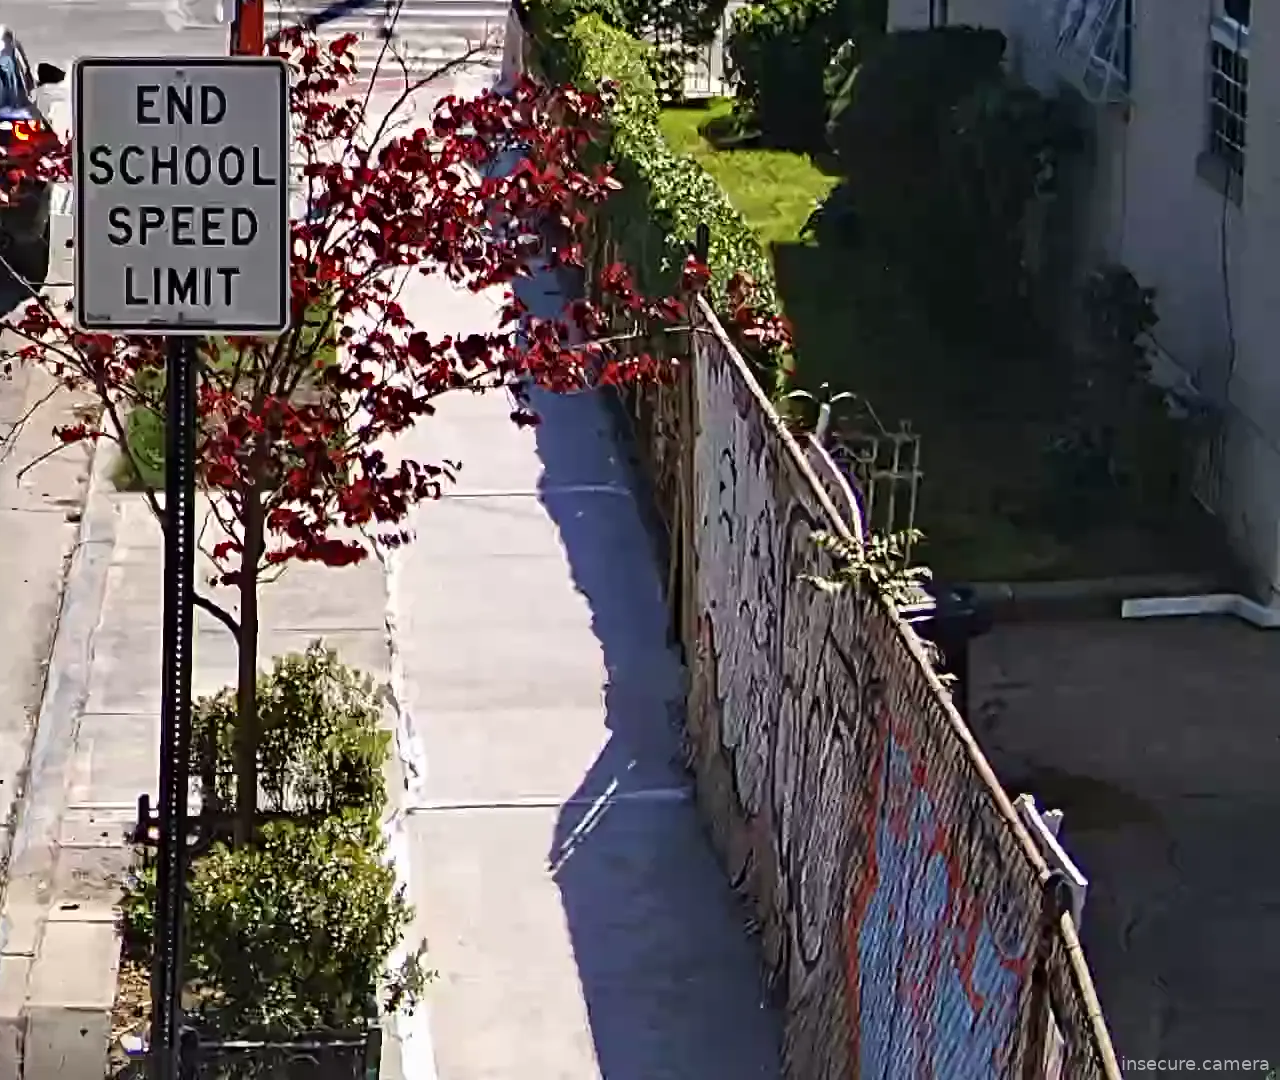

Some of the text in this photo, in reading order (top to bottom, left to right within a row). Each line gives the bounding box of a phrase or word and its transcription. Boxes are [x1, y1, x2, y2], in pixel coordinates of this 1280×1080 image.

[136, 84, 227, 124] END
[89, 144, 277, 186] SCHOOL
[107, 206, 258, 246] SPEED
[125, 266, 240, 306] LIMIT
